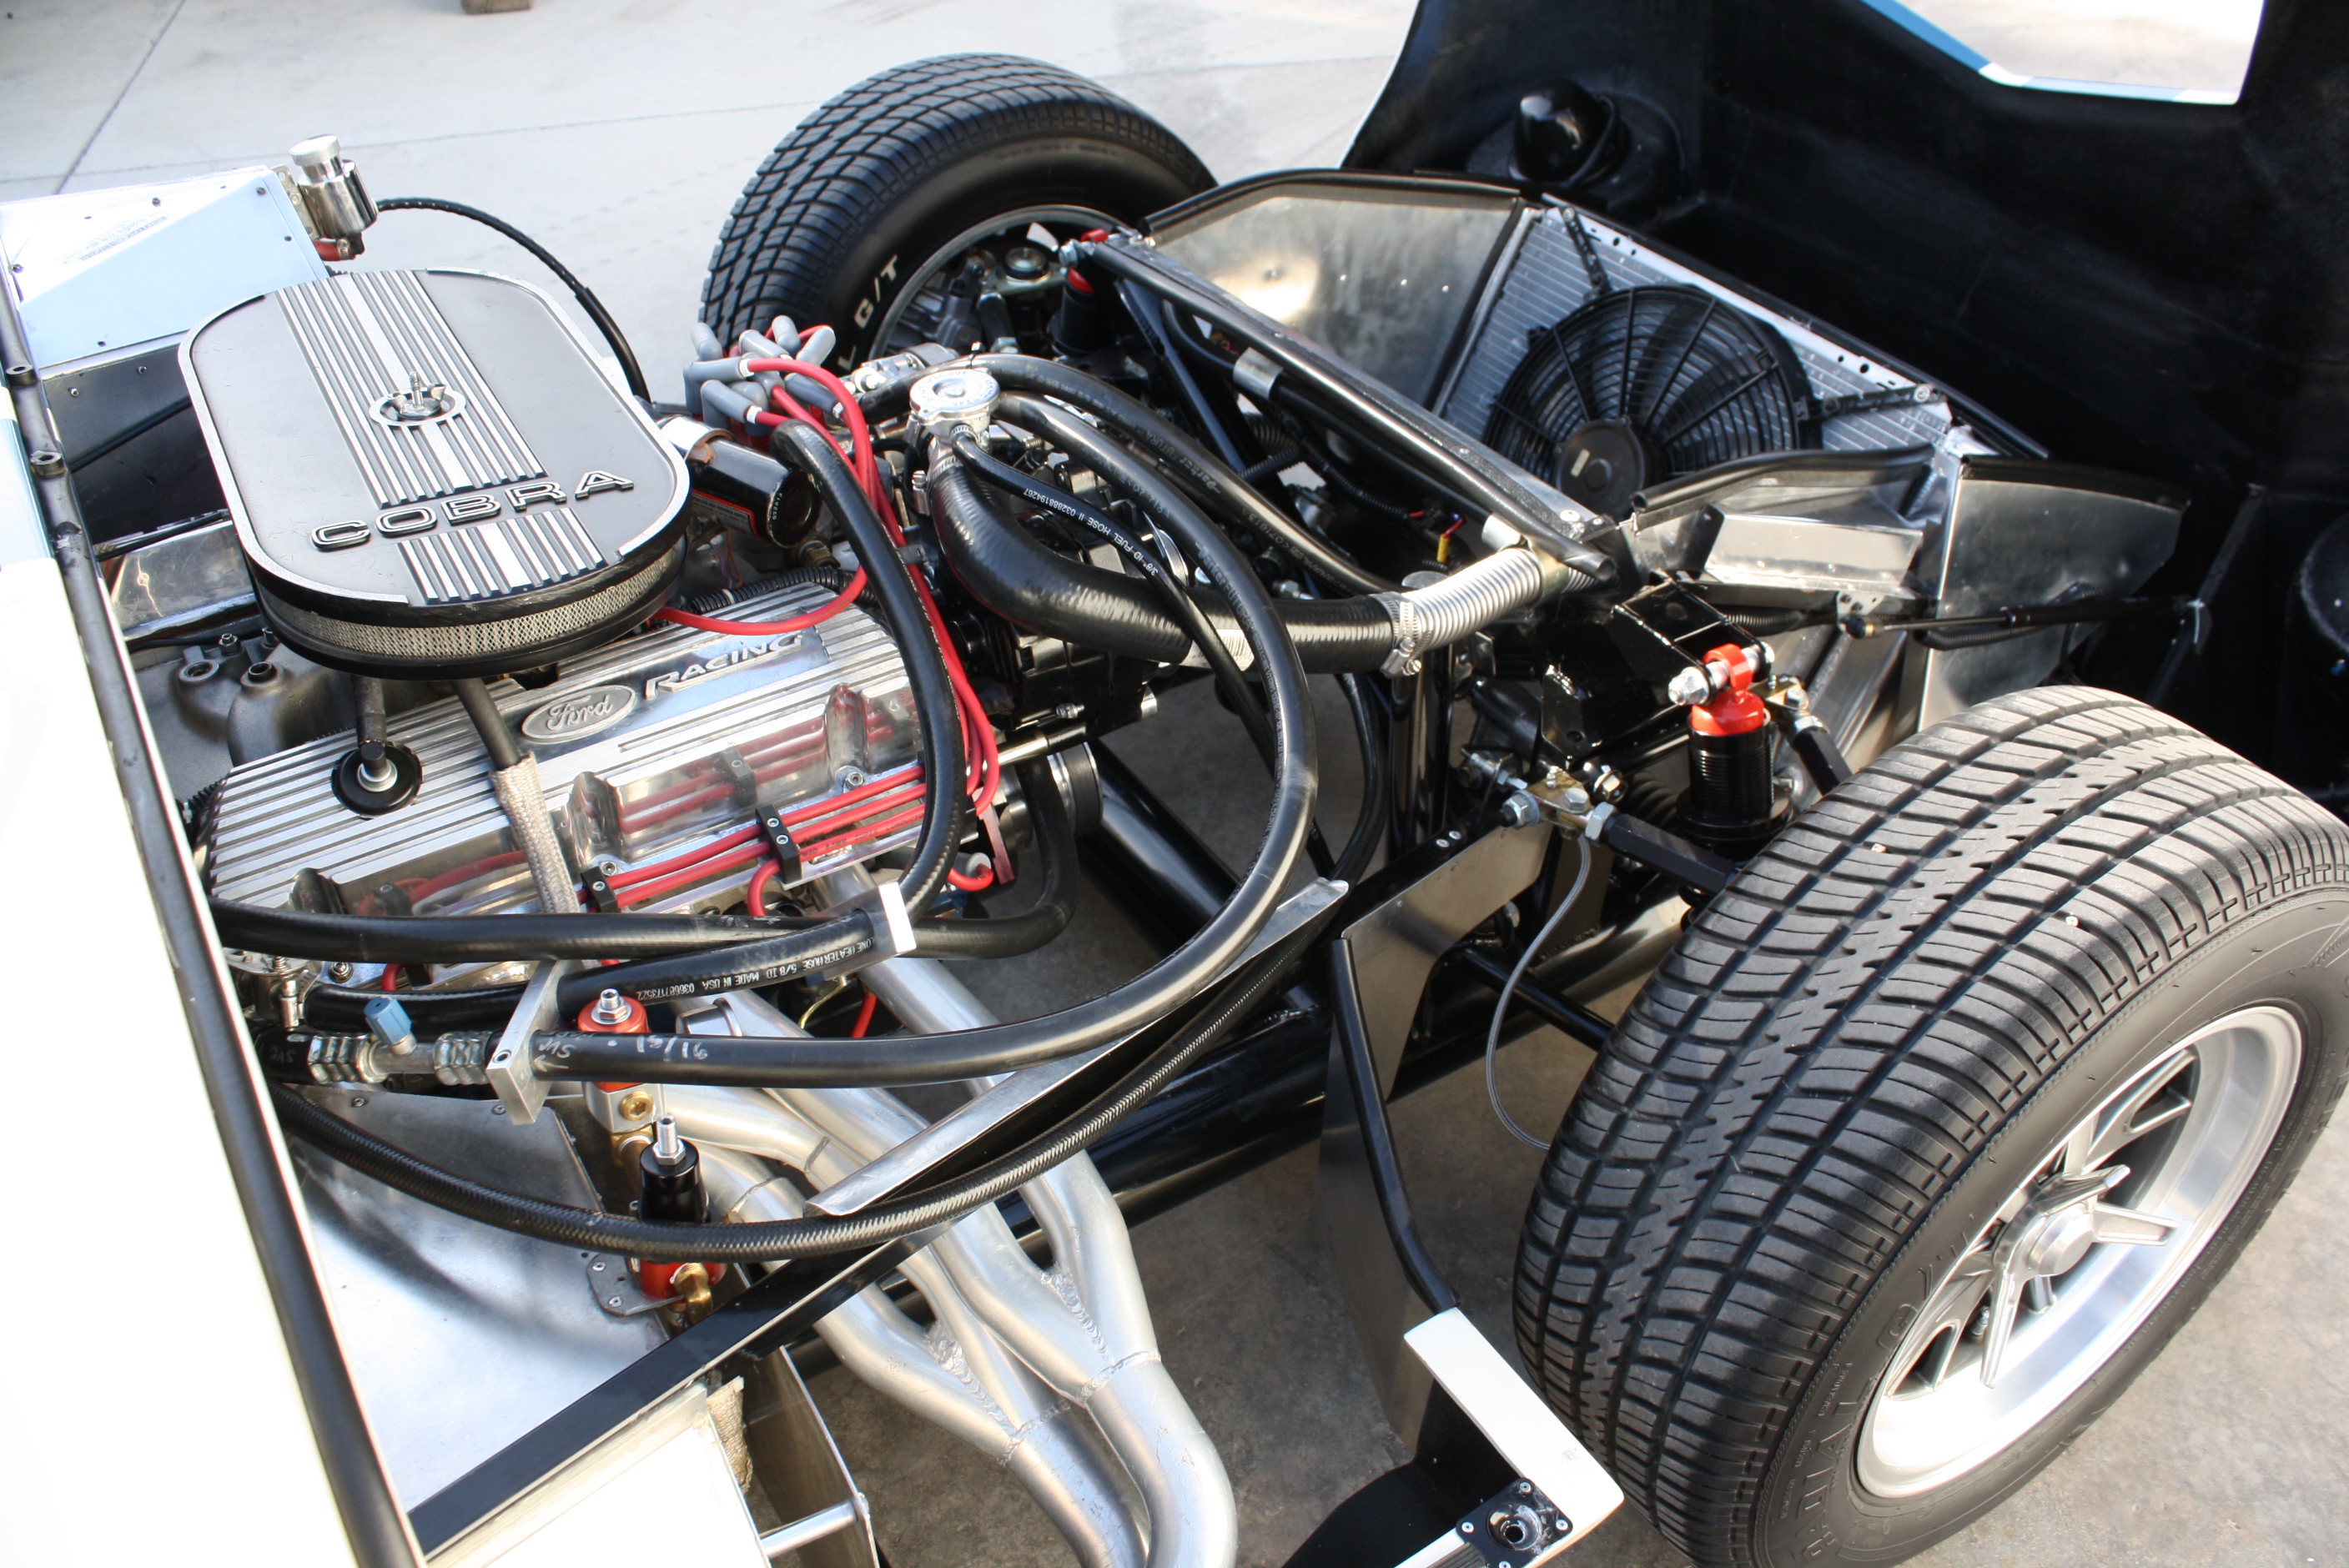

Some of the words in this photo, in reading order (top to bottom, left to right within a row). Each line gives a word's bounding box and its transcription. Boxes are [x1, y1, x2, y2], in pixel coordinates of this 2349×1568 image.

[1023, 488, 1076, 516] 032888194267
[311, 470, 634, 550] COBRA
[1087, 516, 1111, 536] HOSE
[1113, 531, 1134, 553] FUEL
[1133, 550, 1144, 560] ID
[1142, 562, 1159, 576] 3/8"
[645, 633, 802, 700] RACING
[546, 694, 613, 731] Ford
[765, 967, 777, 978] ID
[778, 962, 797, 975] 5/8
[702, 977, 721, 990] USA
[722, 976, 732, 987] IN
[734, 970, 760, 984] MADE
